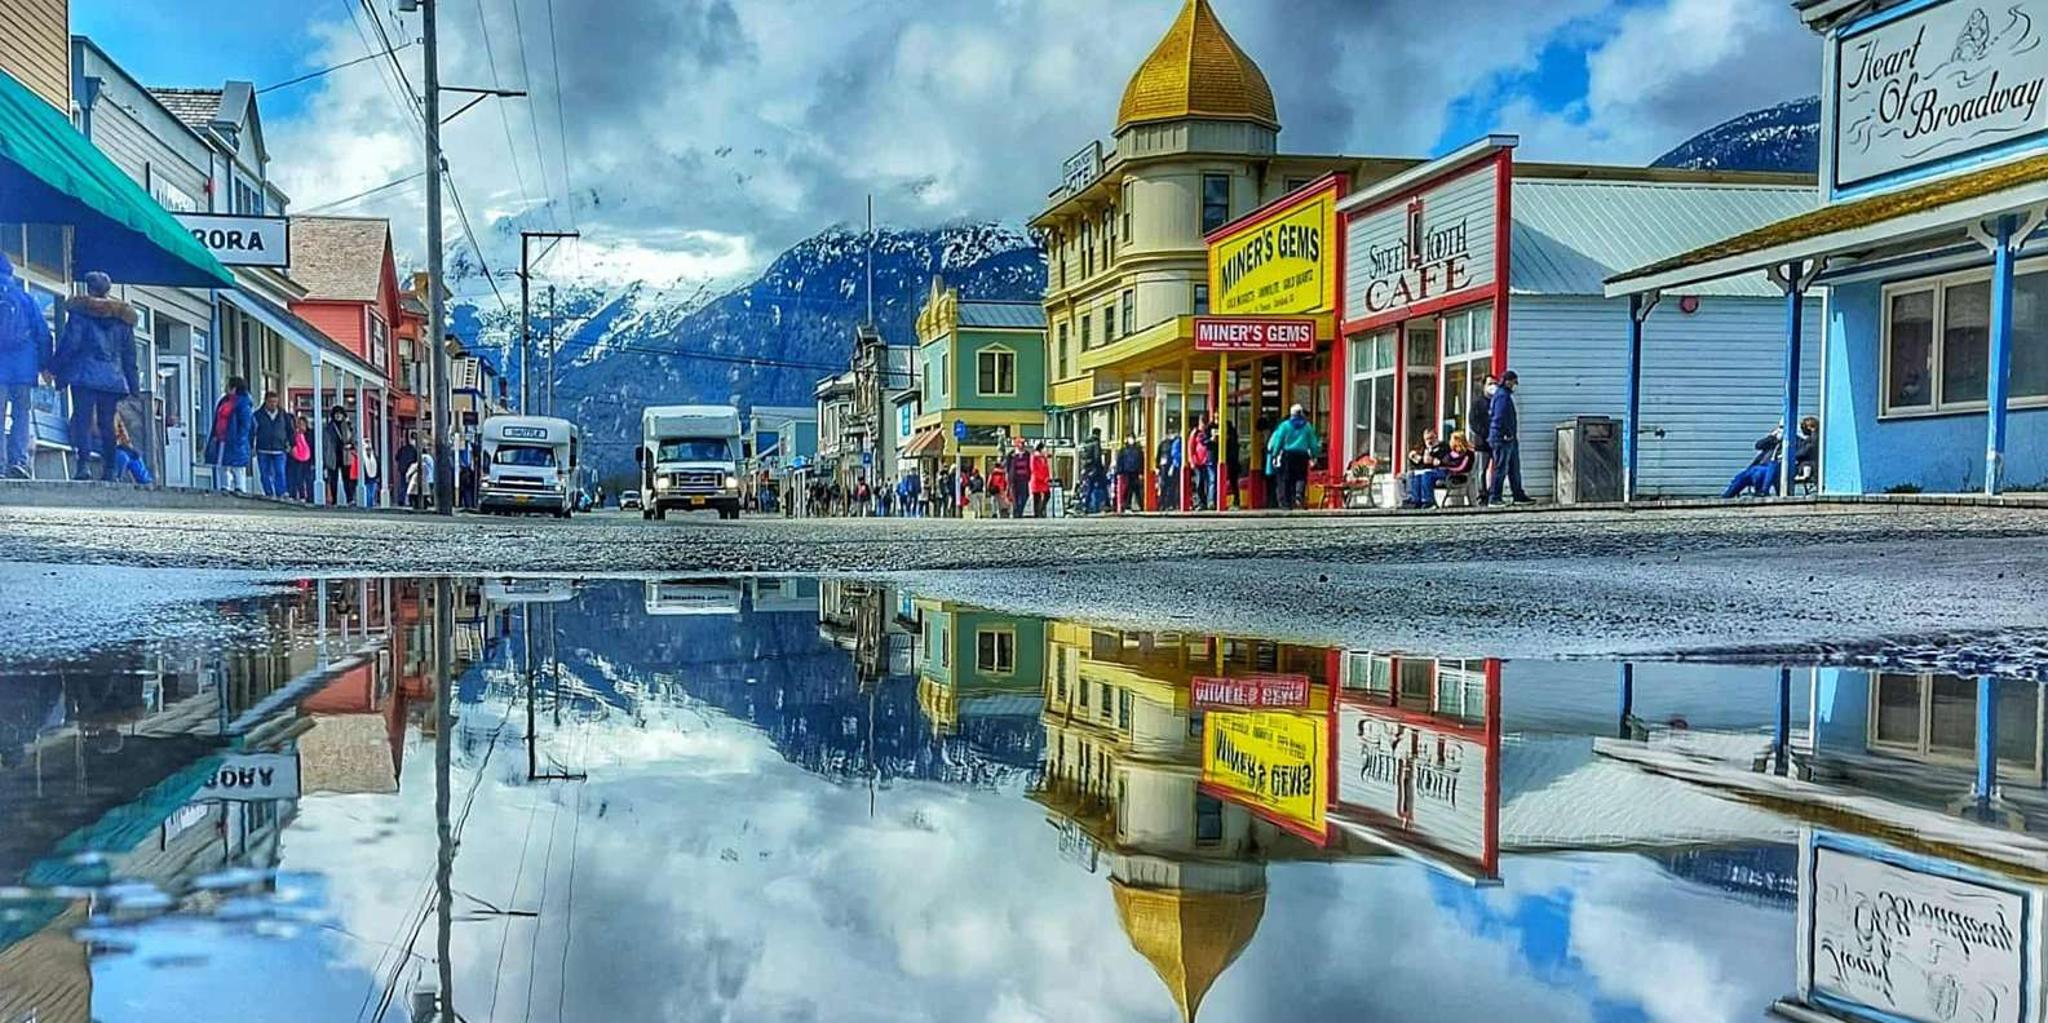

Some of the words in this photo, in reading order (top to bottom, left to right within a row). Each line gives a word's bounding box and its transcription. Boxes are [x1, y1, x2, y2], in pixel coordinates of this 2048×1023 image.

[1848, 25, 1926, 88] Heart
[1880, 73, 1918, 123] Of
[1903, 70, 2045, 139] Broadway
[1221, 228, 1273, 300] MINER'S
[1278, 224, 1319, 262] GEMS
[1366, 252, 1472, 312] CAFE
[1199, 324, 1263, 341] MINER'S
[1267, 325, 1310, 342] GEMS
